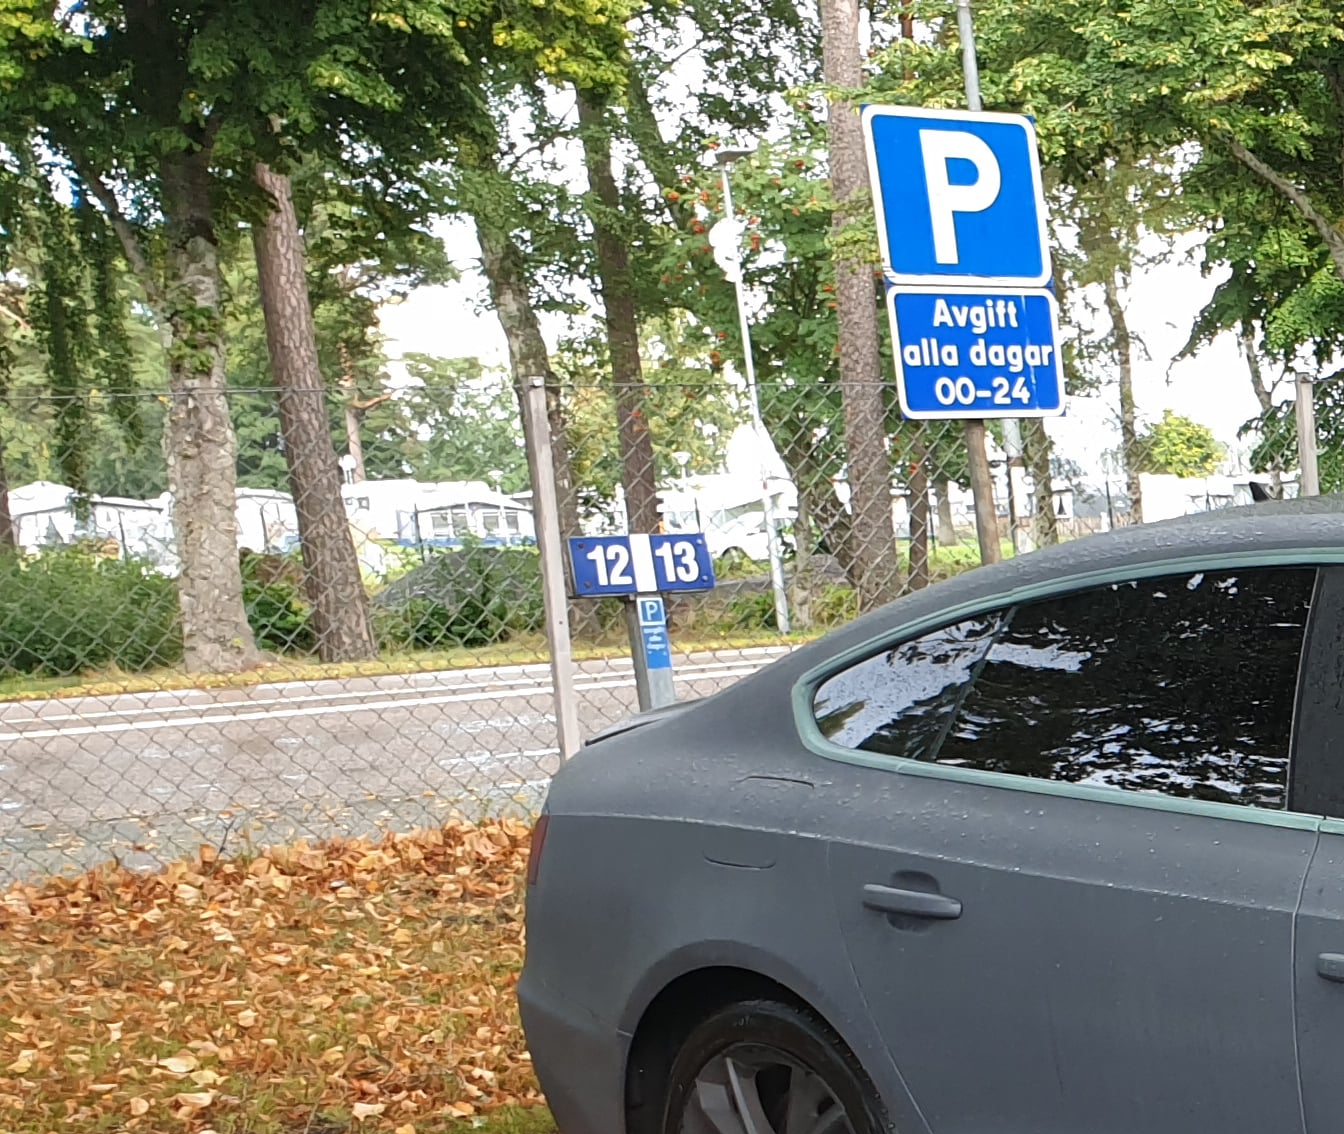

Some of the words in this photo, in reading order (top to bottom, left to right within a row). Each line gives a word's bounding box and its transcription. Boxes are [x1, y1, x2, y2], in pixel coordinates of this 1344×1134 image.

[919, 129, 1001, 265] P
[933, 298, 1018, 334] Avgift
[903, 338, 959, 367] alla
[969, 338, 1053, 373] dagar
[935, 377, 1031, 405] 00-24
[586, 544, 633, 586] 12
[655, 541, 699, 583] 13
[645, 601, 658, 621] P
